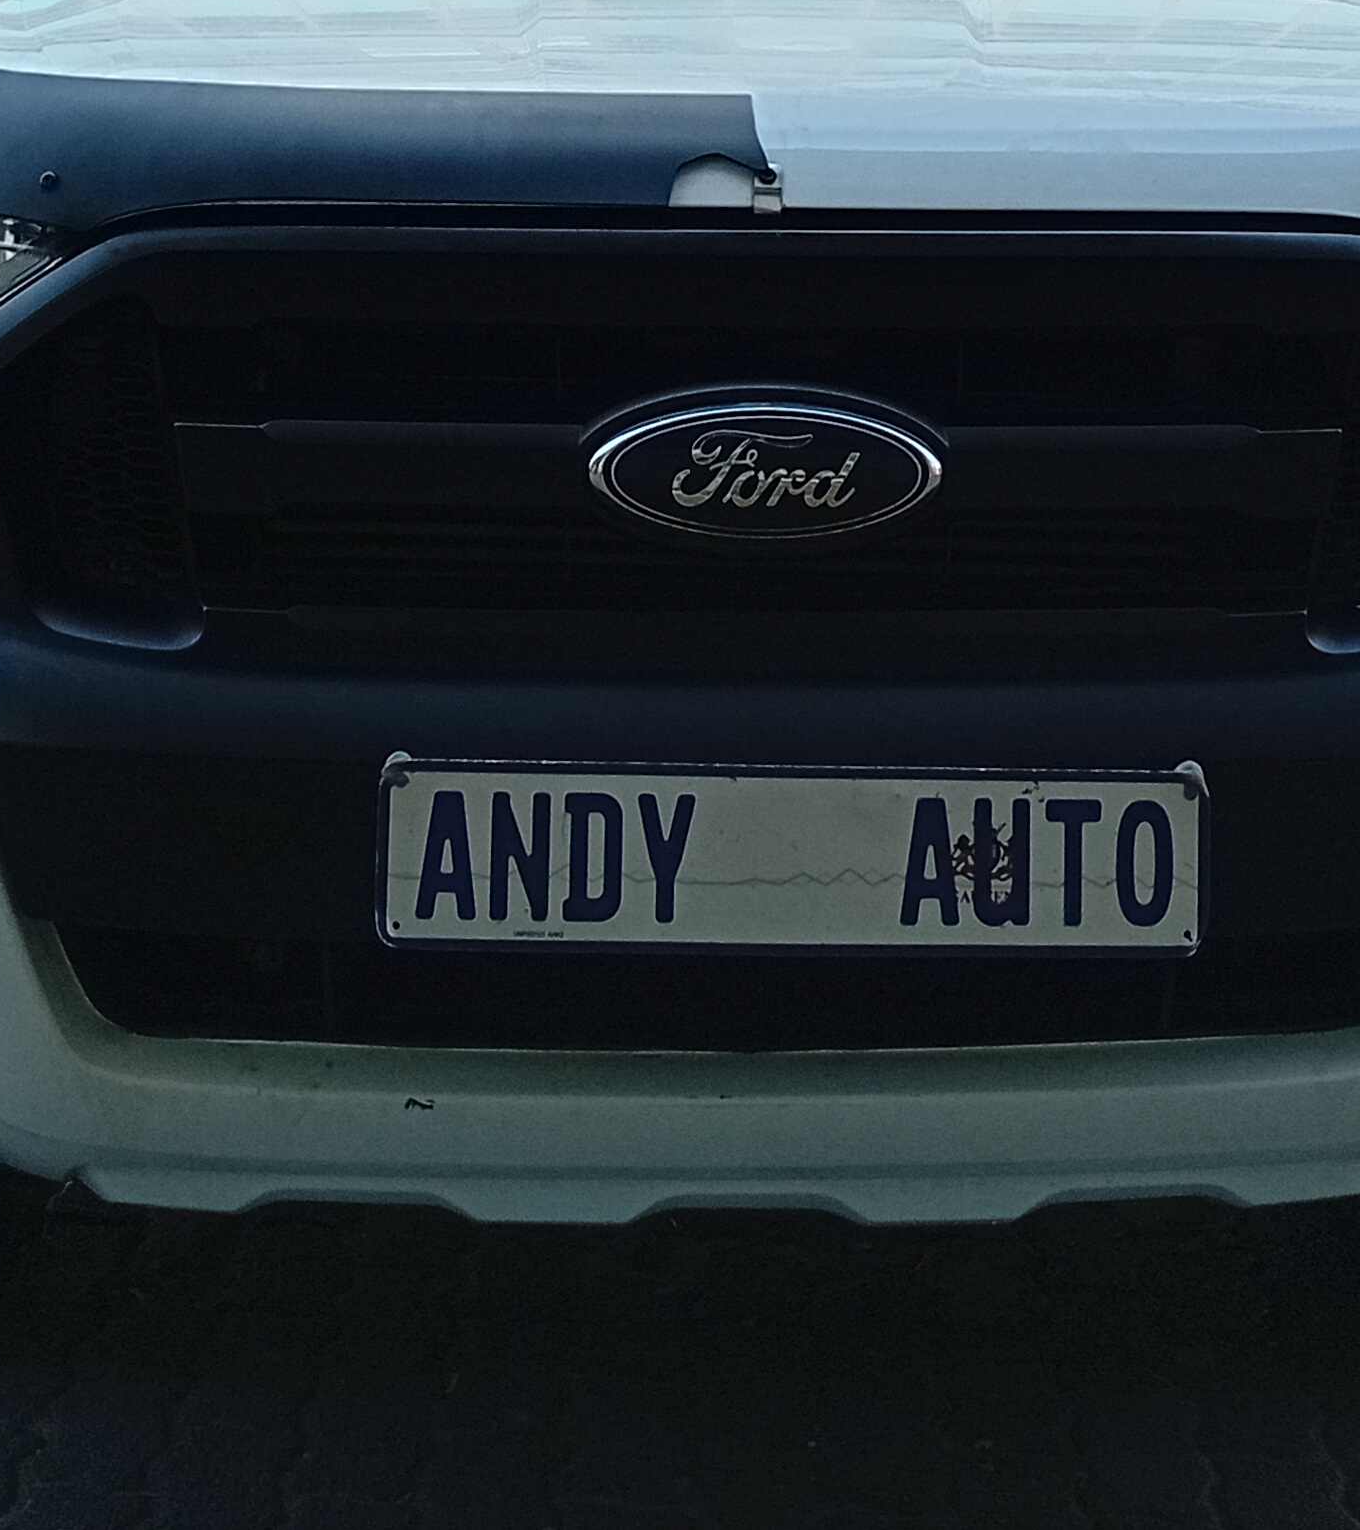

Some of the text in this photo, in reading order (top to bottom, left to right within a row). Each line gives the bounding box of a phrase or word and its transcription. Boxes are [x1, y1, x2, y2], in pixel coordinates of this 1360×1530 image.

[671, 429, 861, 509] Ford
[414, 790, 1175, 927] ANDY AUTO
